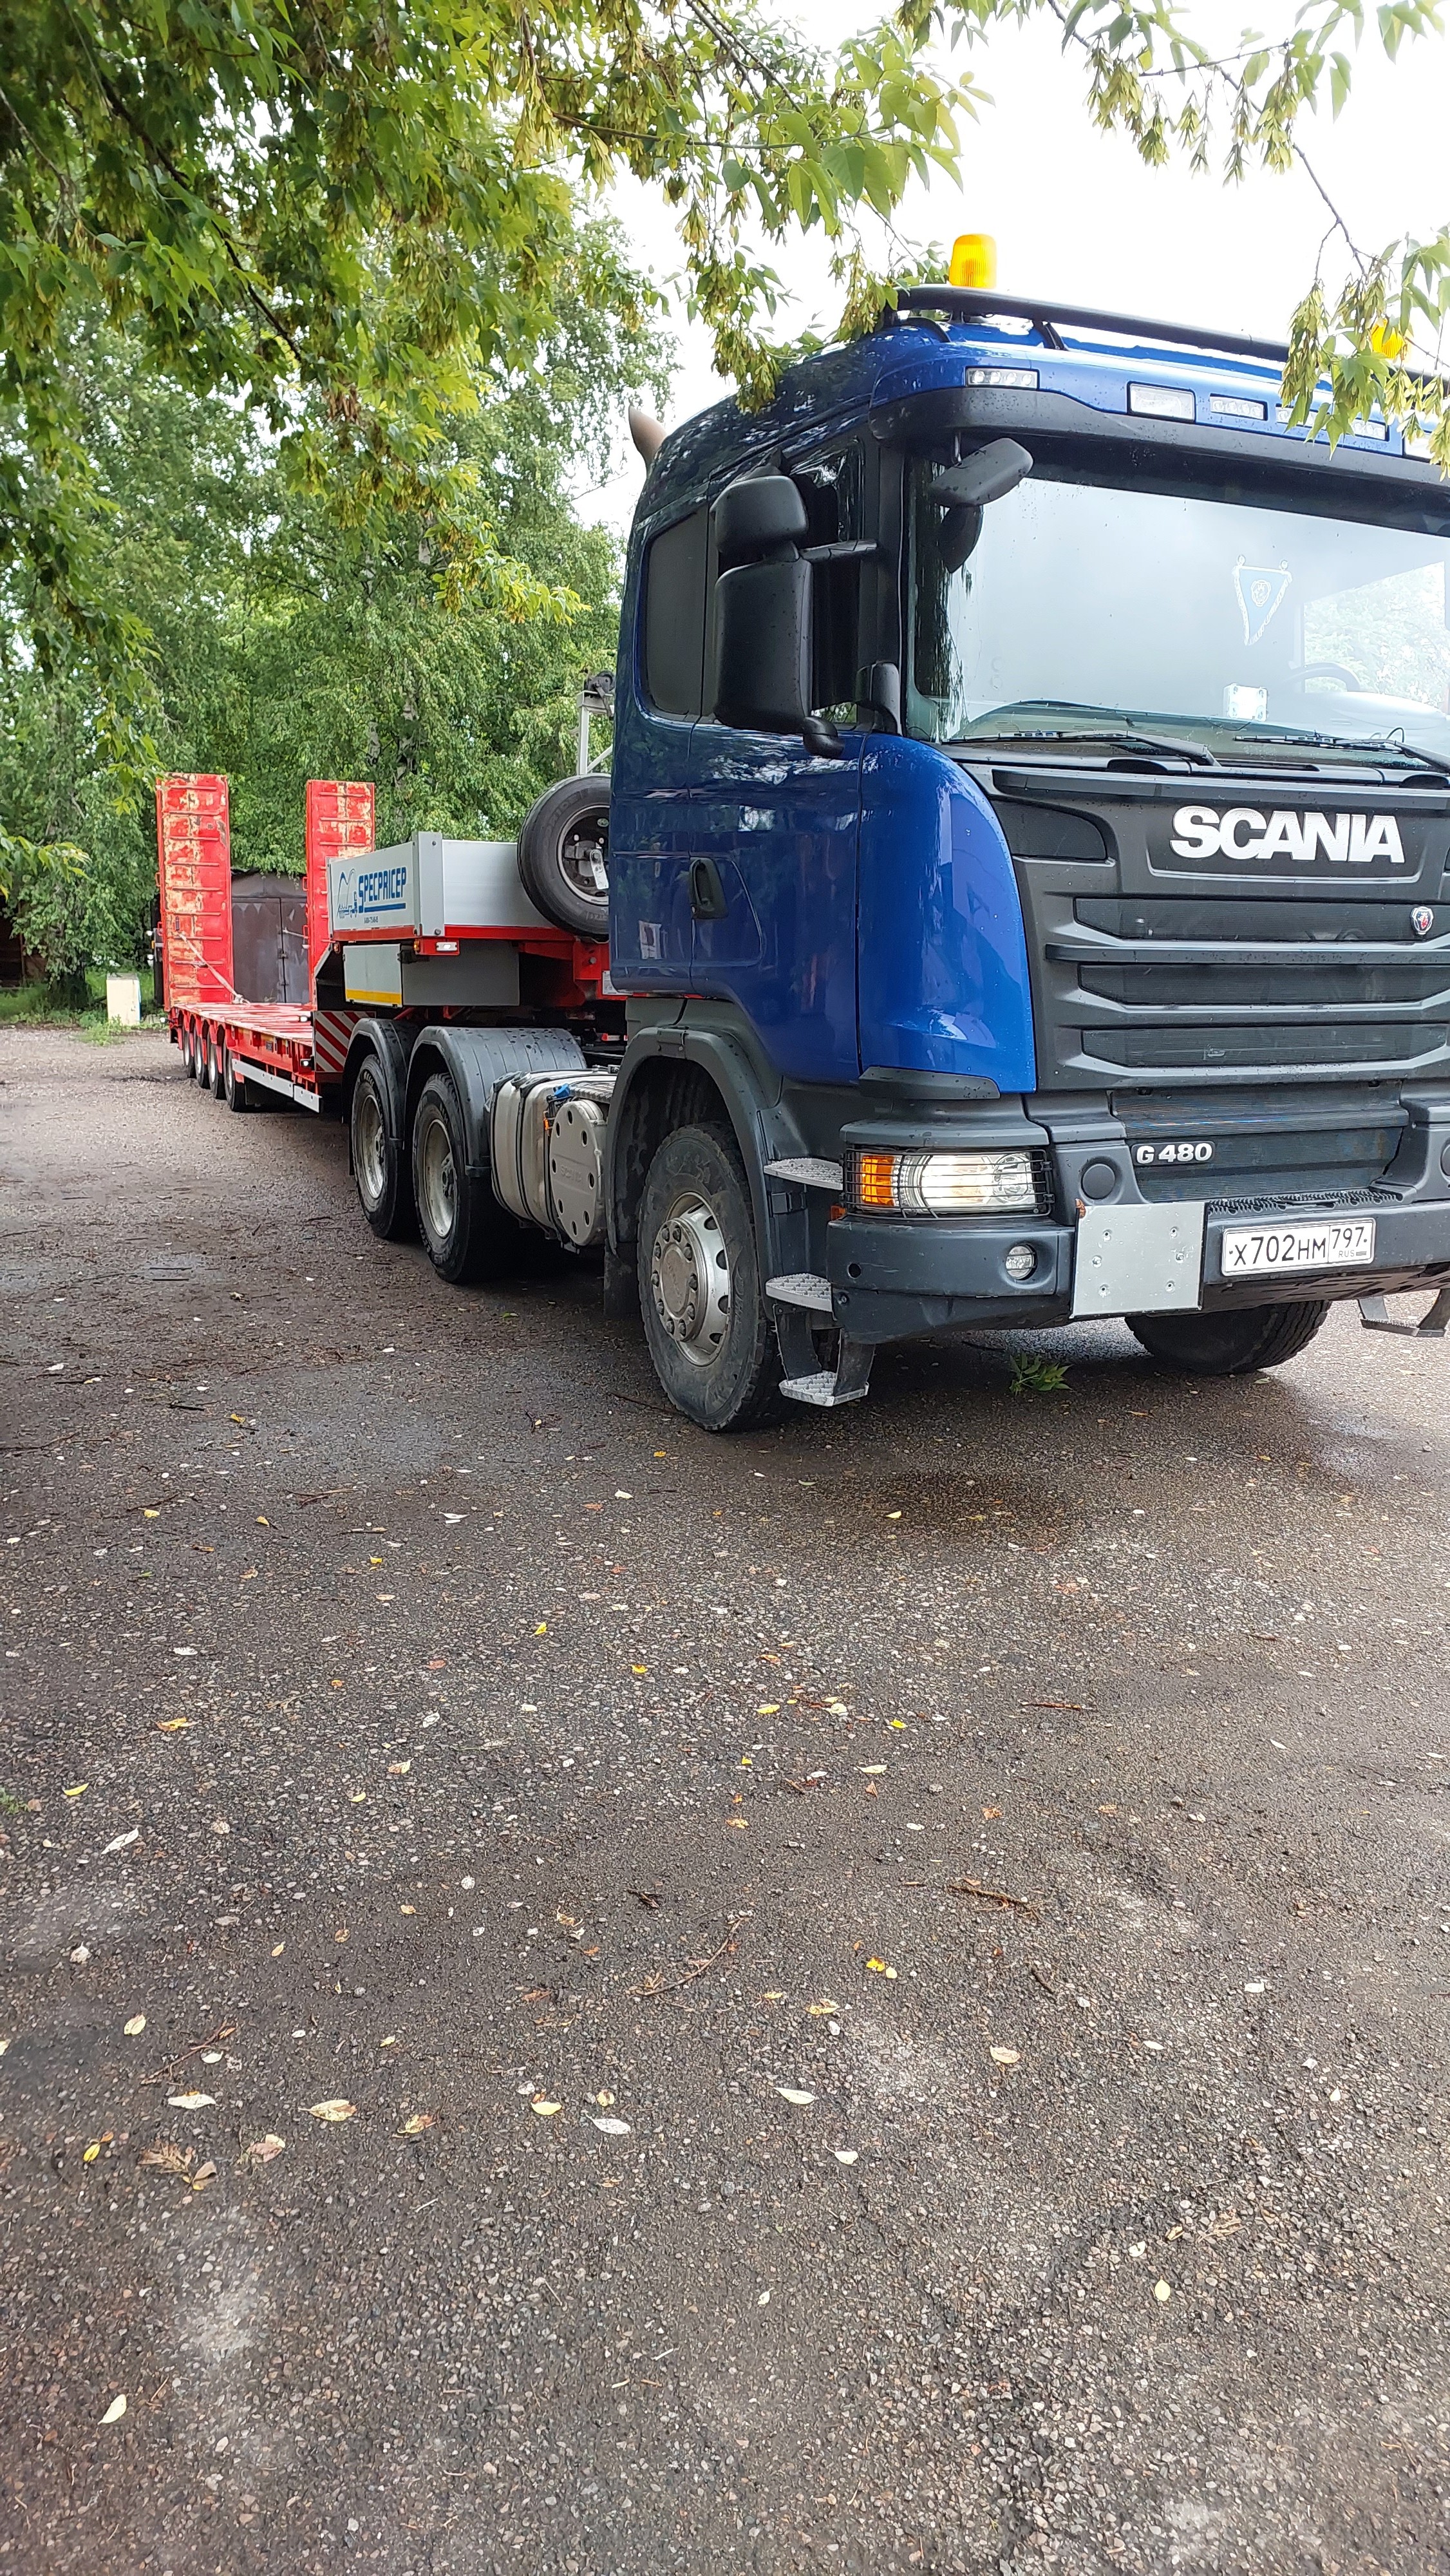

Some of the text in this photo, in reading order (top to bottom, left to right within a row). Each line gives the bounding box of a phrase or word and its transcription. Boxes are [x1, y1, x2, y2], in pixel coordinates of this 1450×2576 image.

[1169, 805, 1406, 864] SCANIA
[358, 866, 407, 914] SPECPRICEP
[1136, 1142, 1212, 1164] G 480
[1331, 1226, 1365, 1249] 797
[1338, 1249, 1355, 1258] RUS
